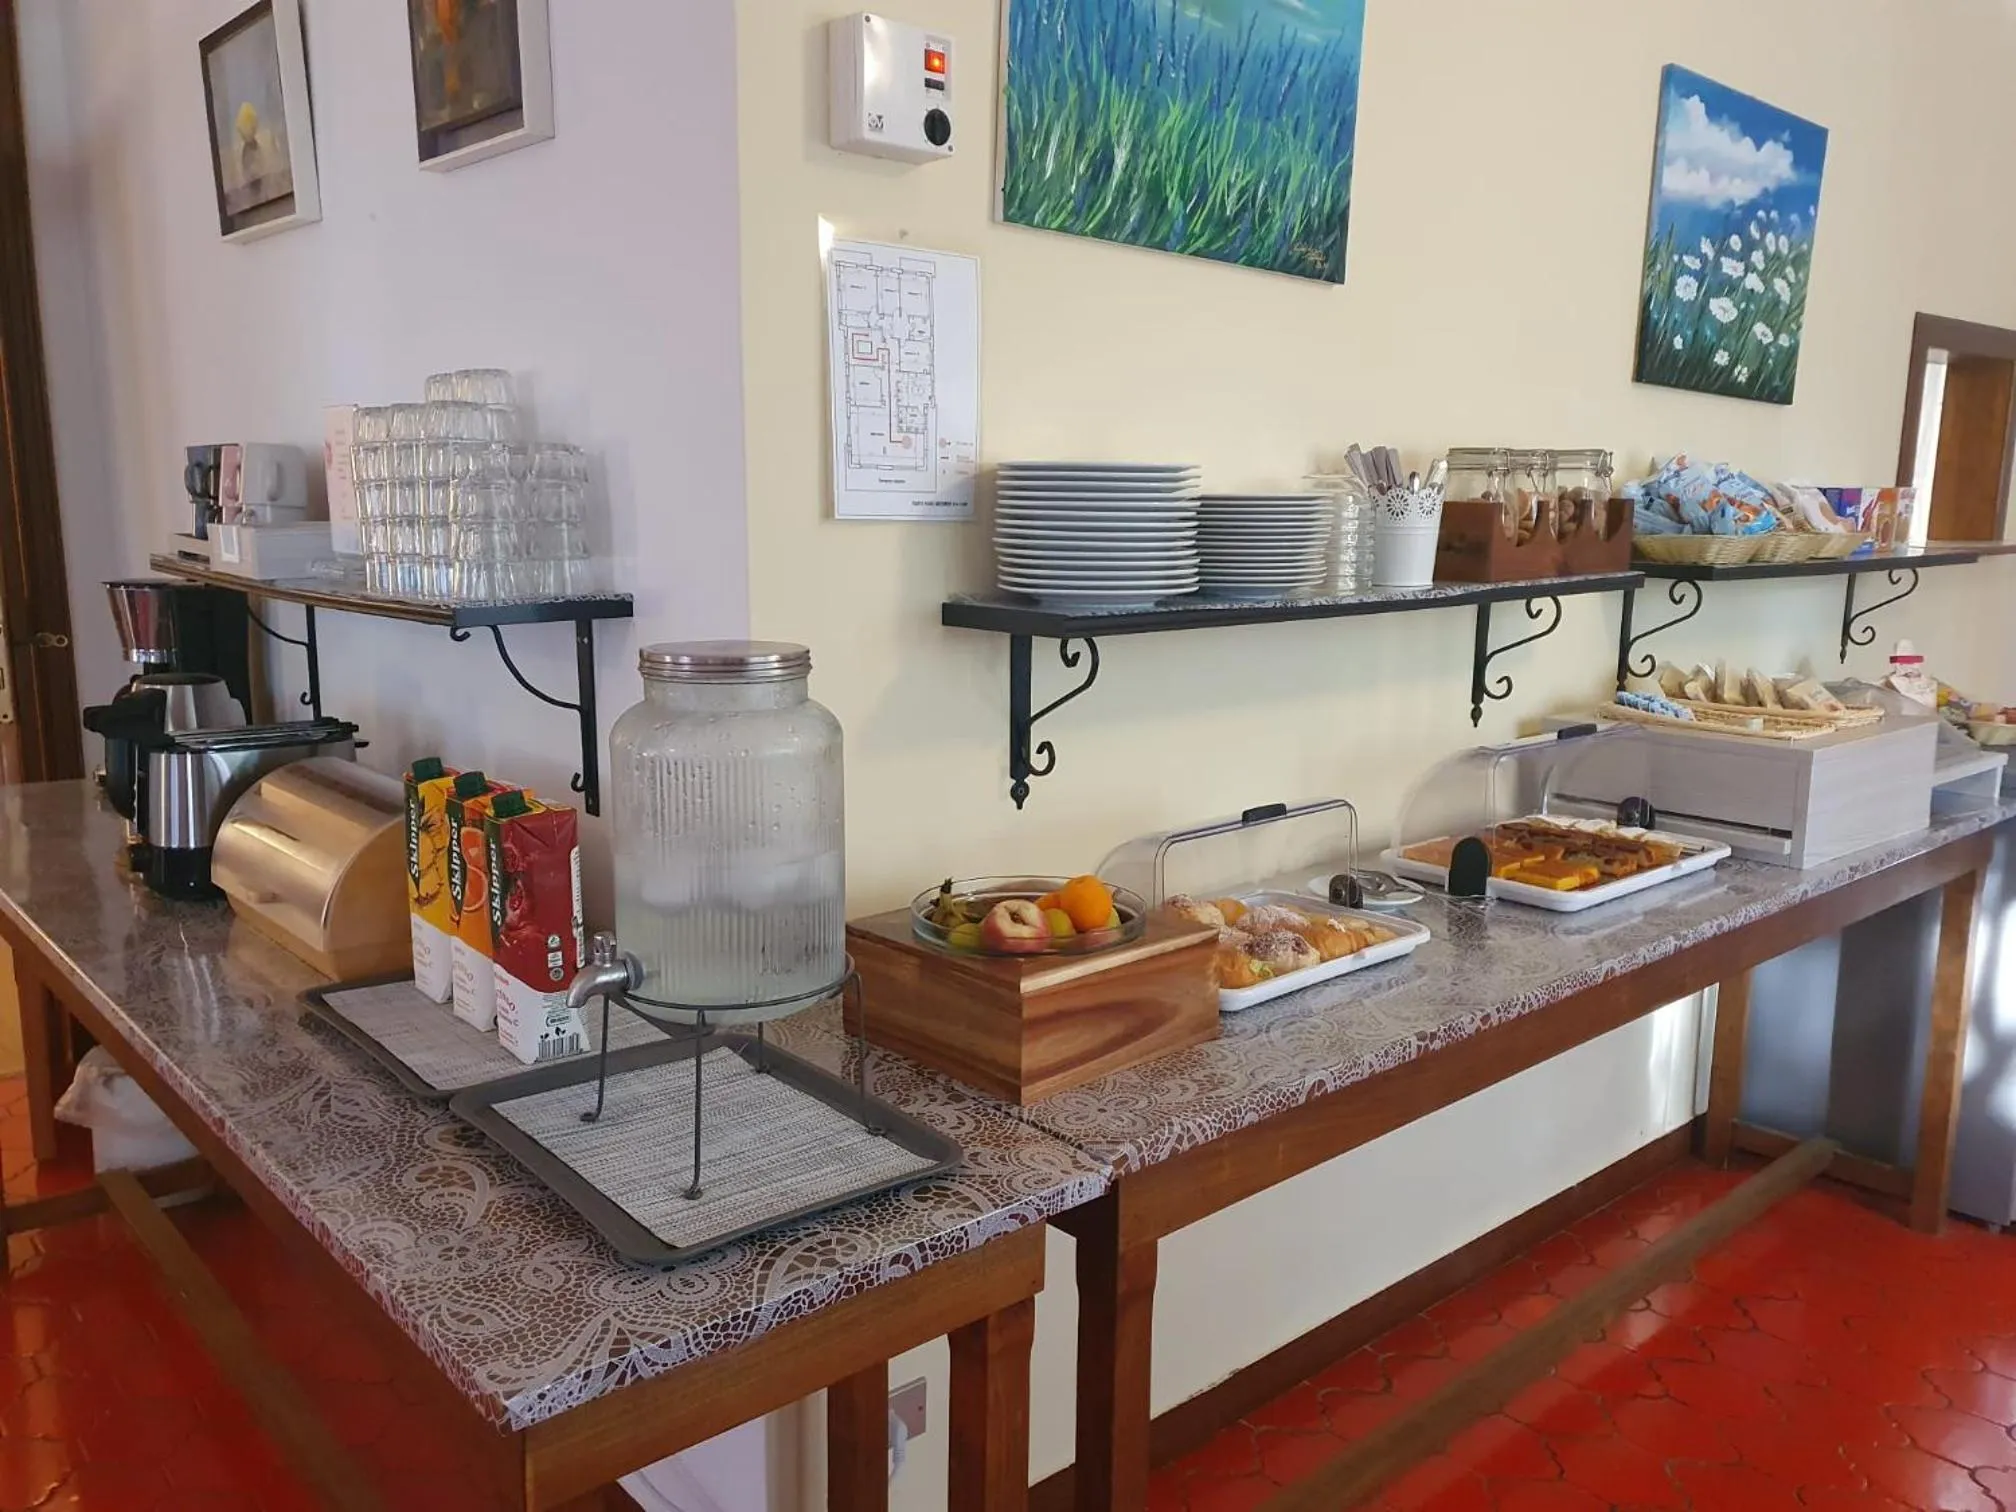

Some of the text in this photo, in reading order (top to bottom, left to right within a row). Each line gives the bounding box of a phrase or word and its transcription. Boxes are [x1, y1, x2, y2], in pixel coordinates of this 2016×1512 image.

[410, 800, 419, 878] Skipper
[451, 818, 462, 900] Skipper
[491, 839, 502, 926] Skipper
